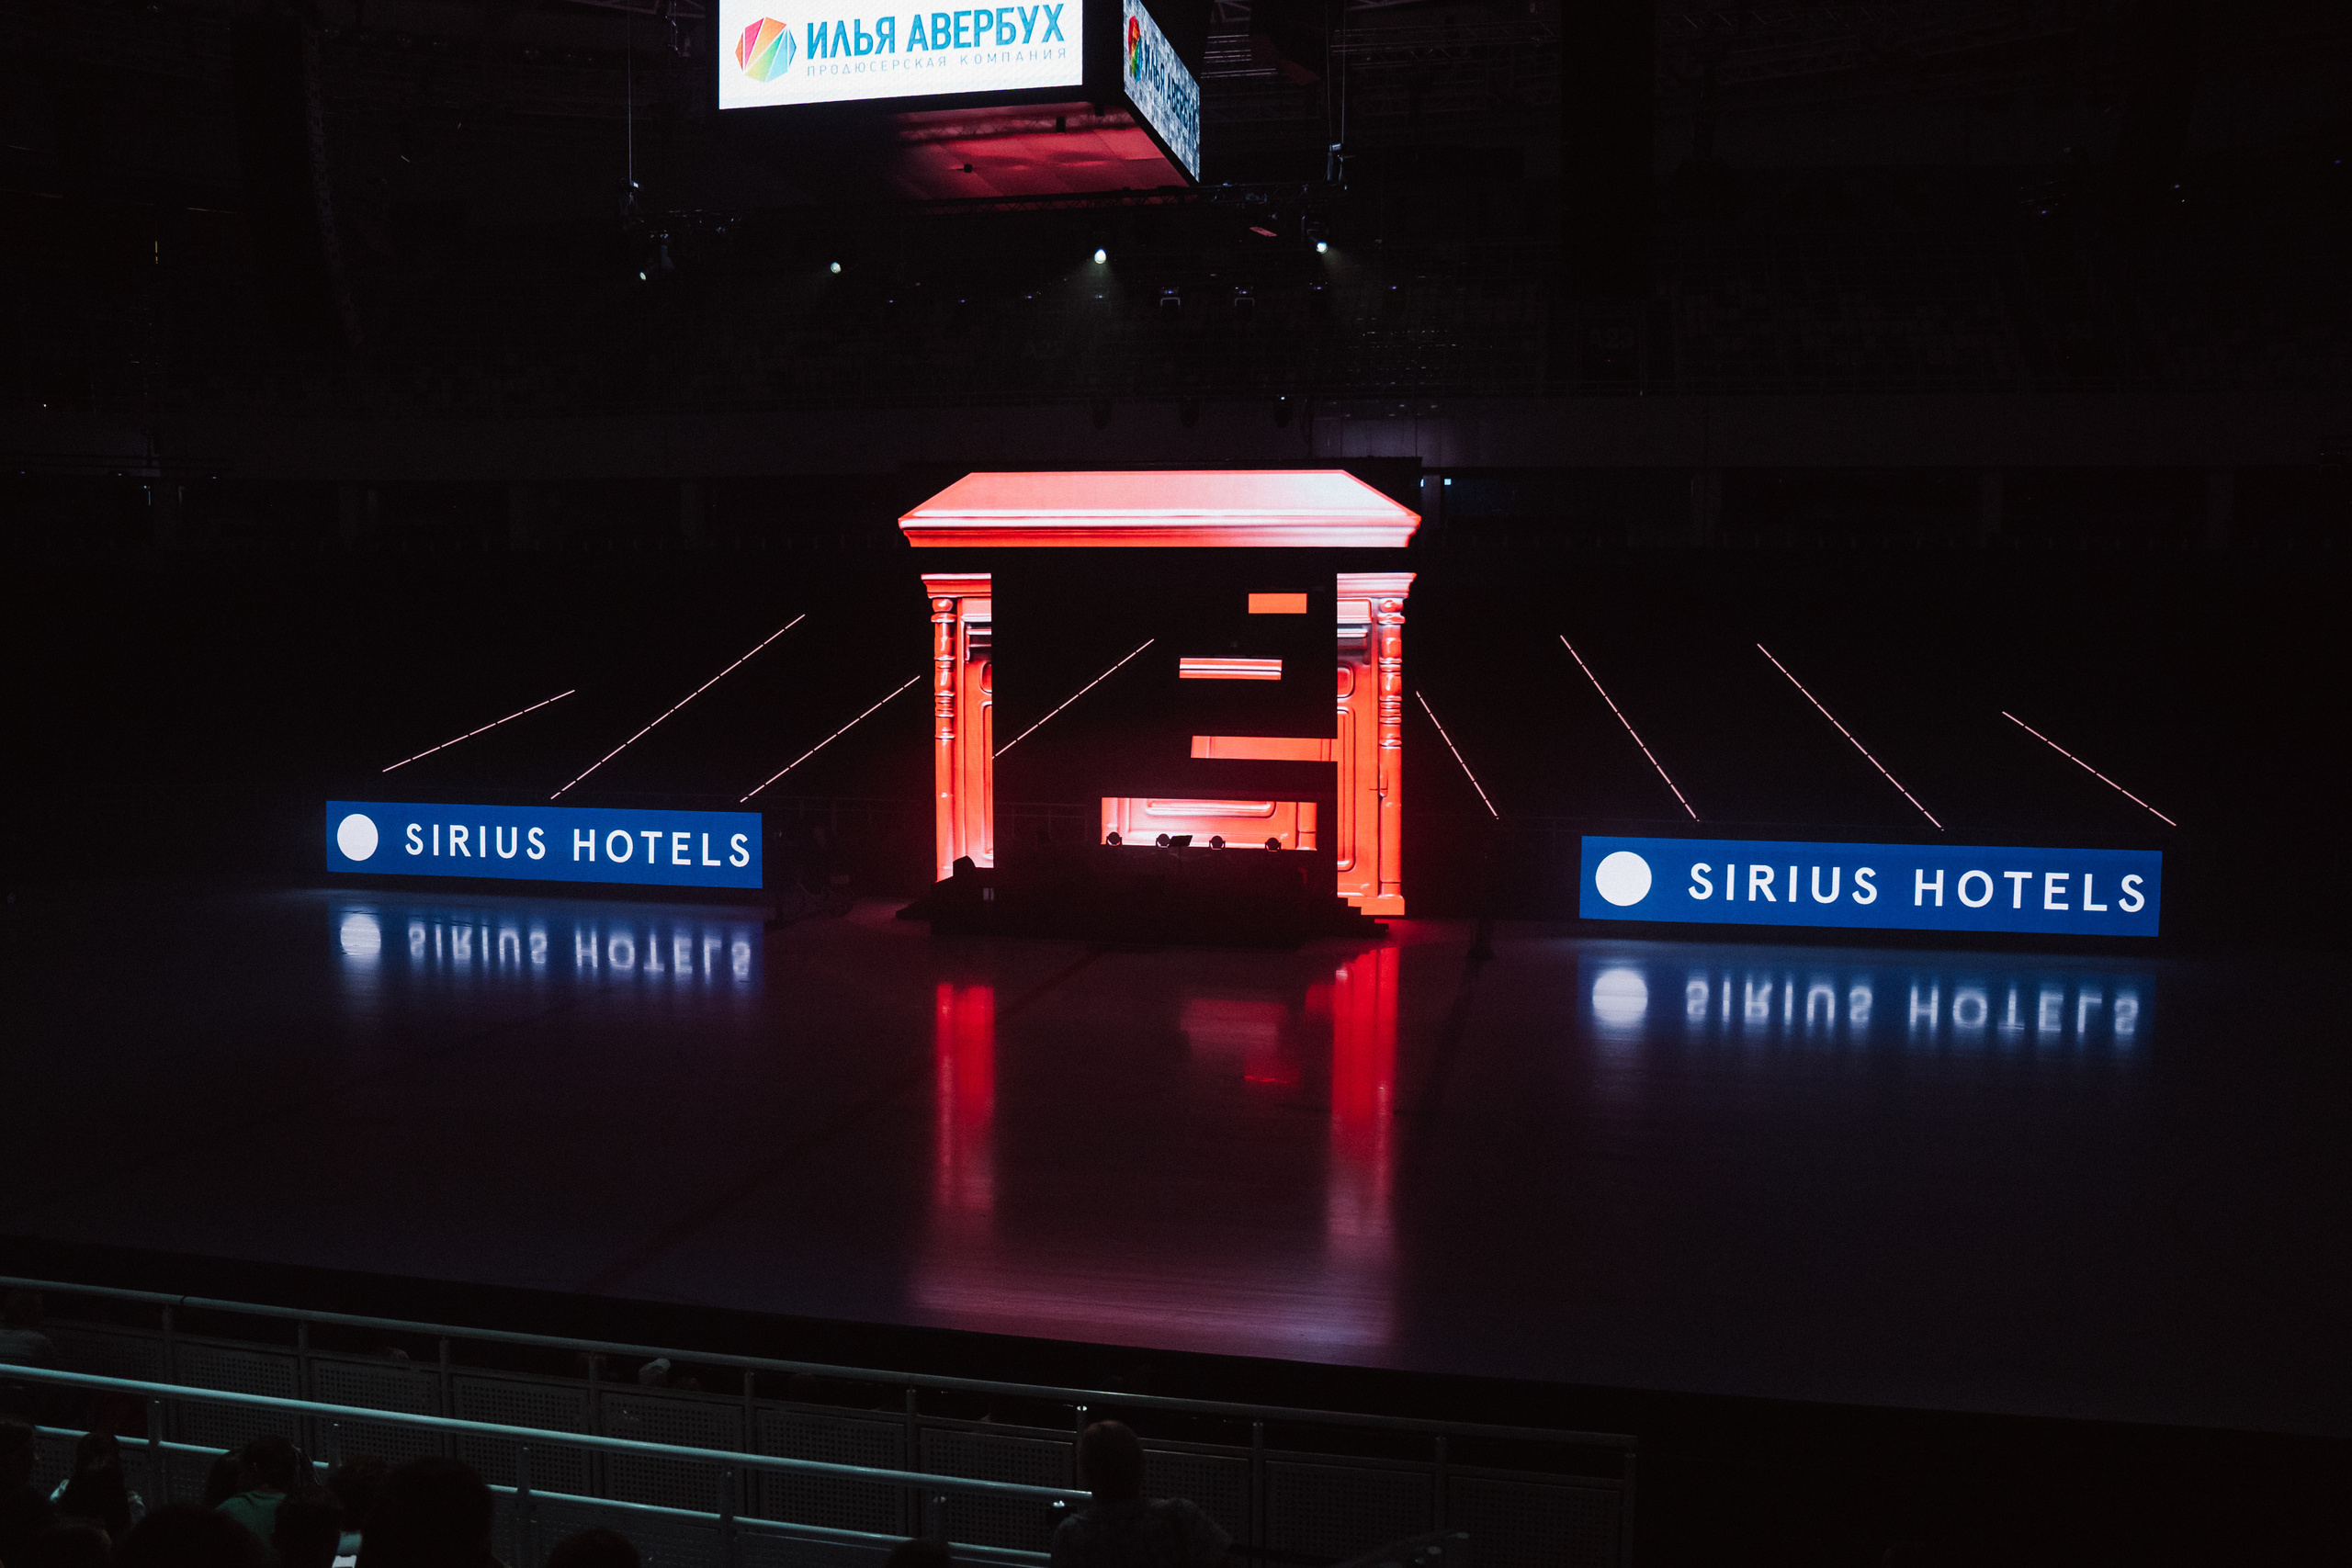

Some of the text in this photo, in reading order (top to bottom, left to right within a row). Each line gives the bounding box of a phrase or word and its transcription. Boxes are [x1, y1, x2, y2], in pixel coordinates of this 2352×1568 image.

[807, 3, 1066, 60] ИЛЬЯ АВЕРБУХ
[807, 47, 1067, 77] ПРОДЮСЕРСКАЯ КОМПАНИЯ
[405, 823, 751, 868] SIRIUS HOTELS
[1688, 863, 2146, 913] SIRIUS HOTELS
